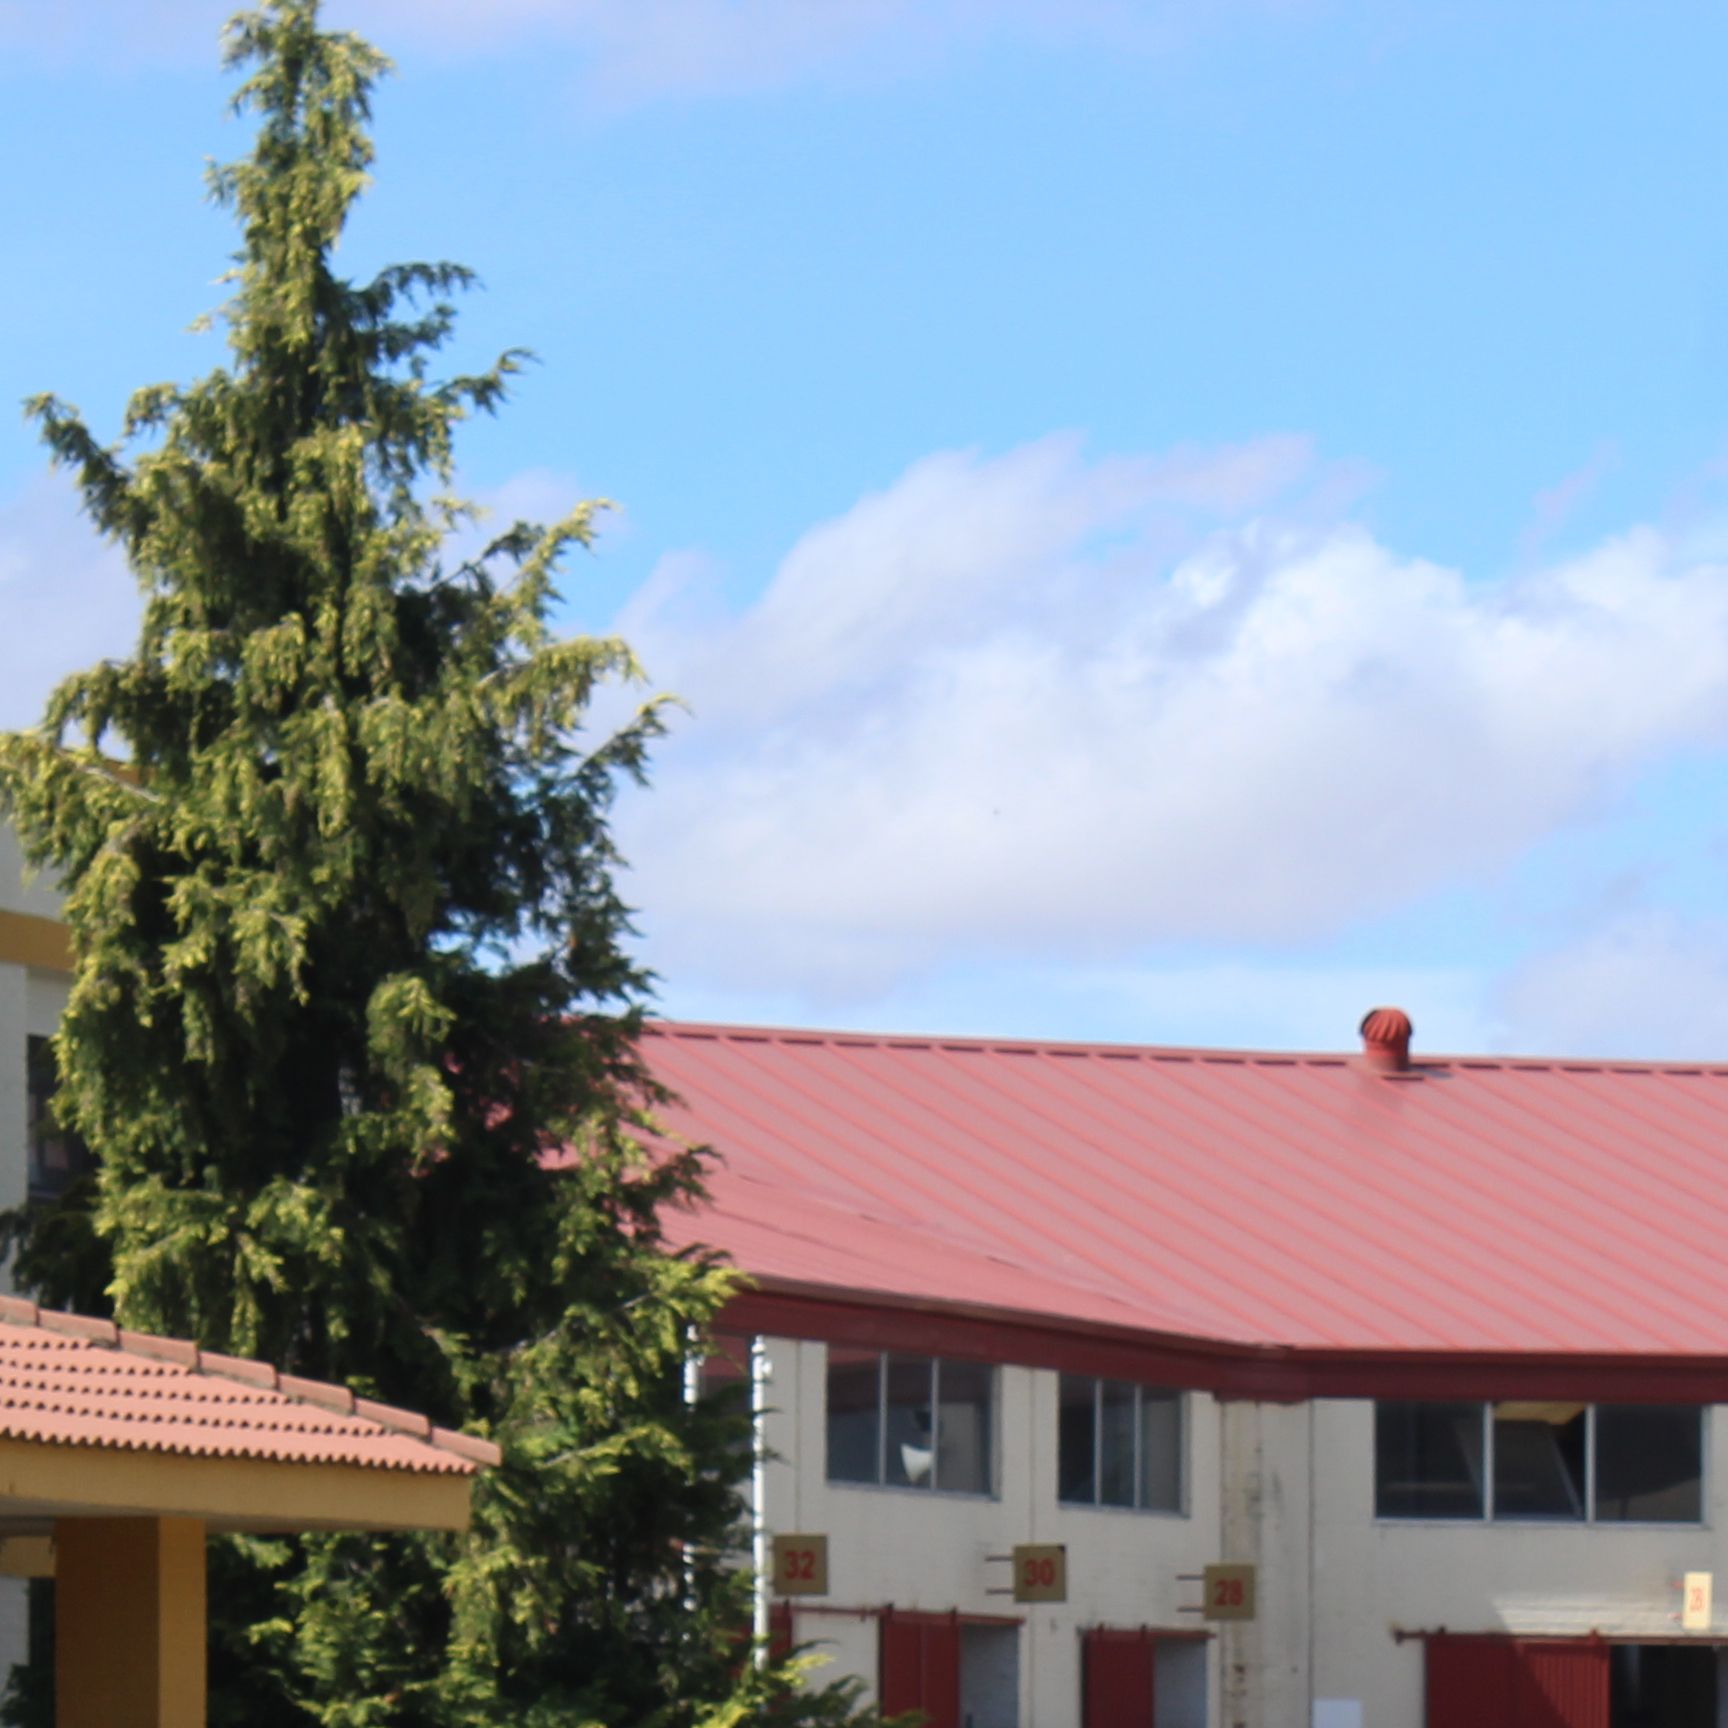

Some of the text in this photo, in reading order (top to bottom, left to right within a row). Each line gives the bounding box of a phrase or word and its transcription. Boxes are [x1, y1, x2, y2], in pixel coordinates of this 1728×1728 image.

[784, 1549, 816, 1580] 32
[1024, 1558, 1056, 1586] 30
[1215, 1579, 1244, 1607] 28
